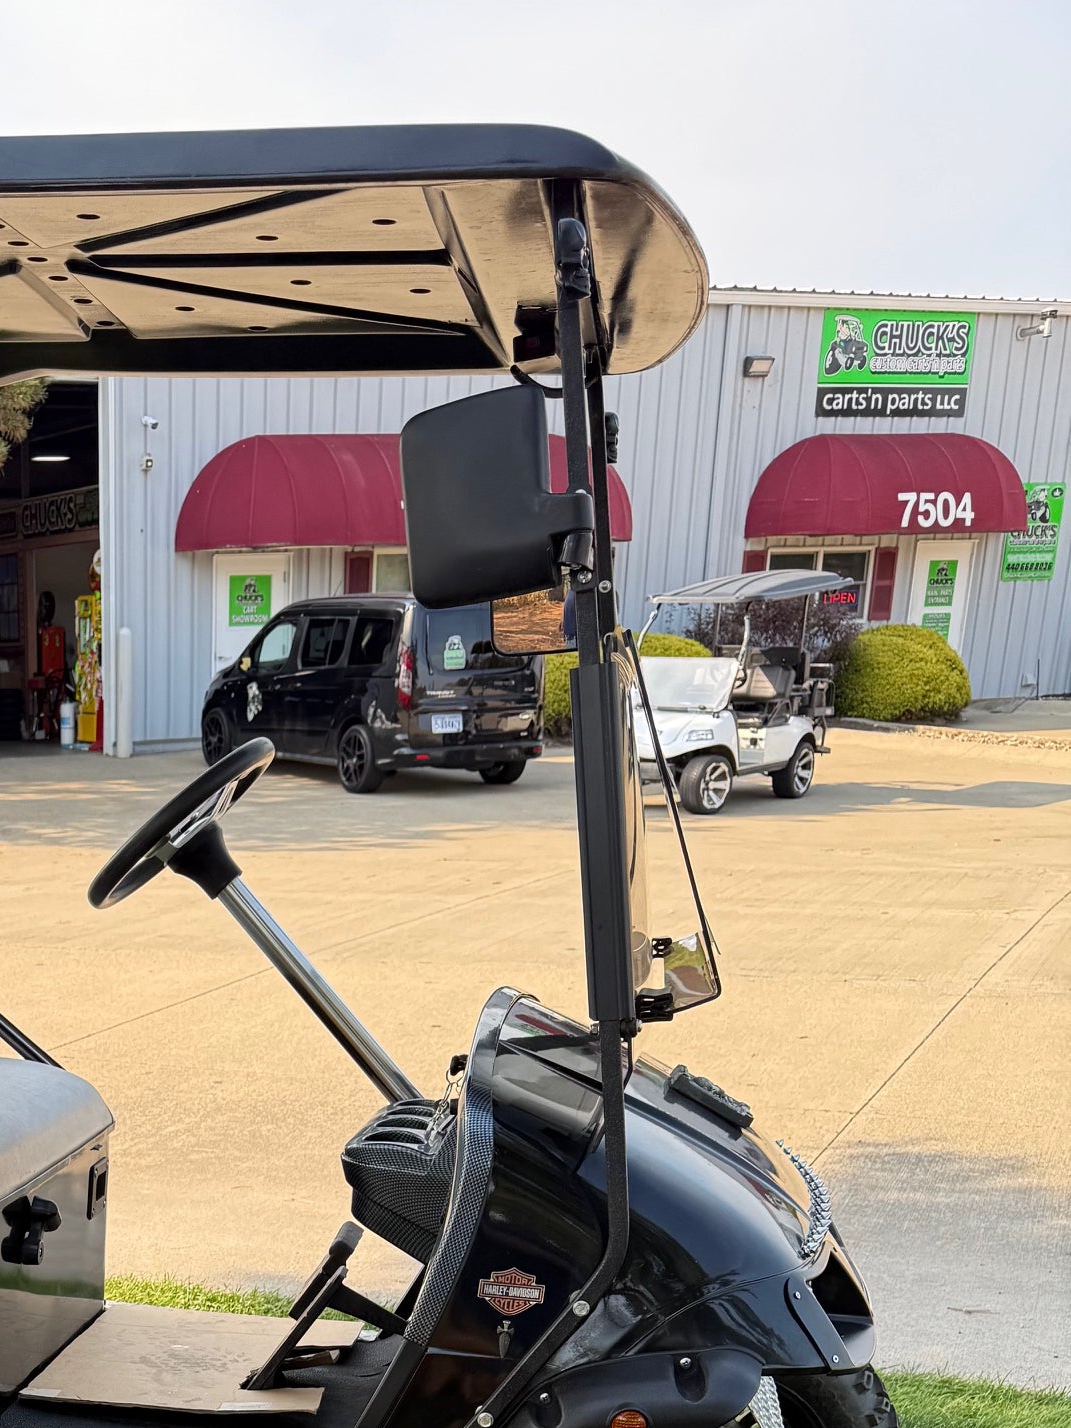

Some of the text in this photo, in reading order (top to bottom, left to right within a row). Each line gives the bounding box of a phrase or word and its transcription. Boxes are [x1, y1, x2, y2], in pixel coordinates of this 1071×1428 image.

[872, 321, 969, 355] CHUCK'S
[870, 355, 907, 372] custom
[939, 355, 966, 375] parts
[822, 388, 961, 414] carts'n parts LLC
[22, 493, 76, 535] CHUCK'S
[897, 491, 975, 528] 7504
[823, 592, 856, 605] OPEN
[497, 1273, 528, 1286] MOTOR
[483, 1284, 540, 1299] HARLEY-DAVIDSON
[495, 1298, 526, 1312] CYCLES
